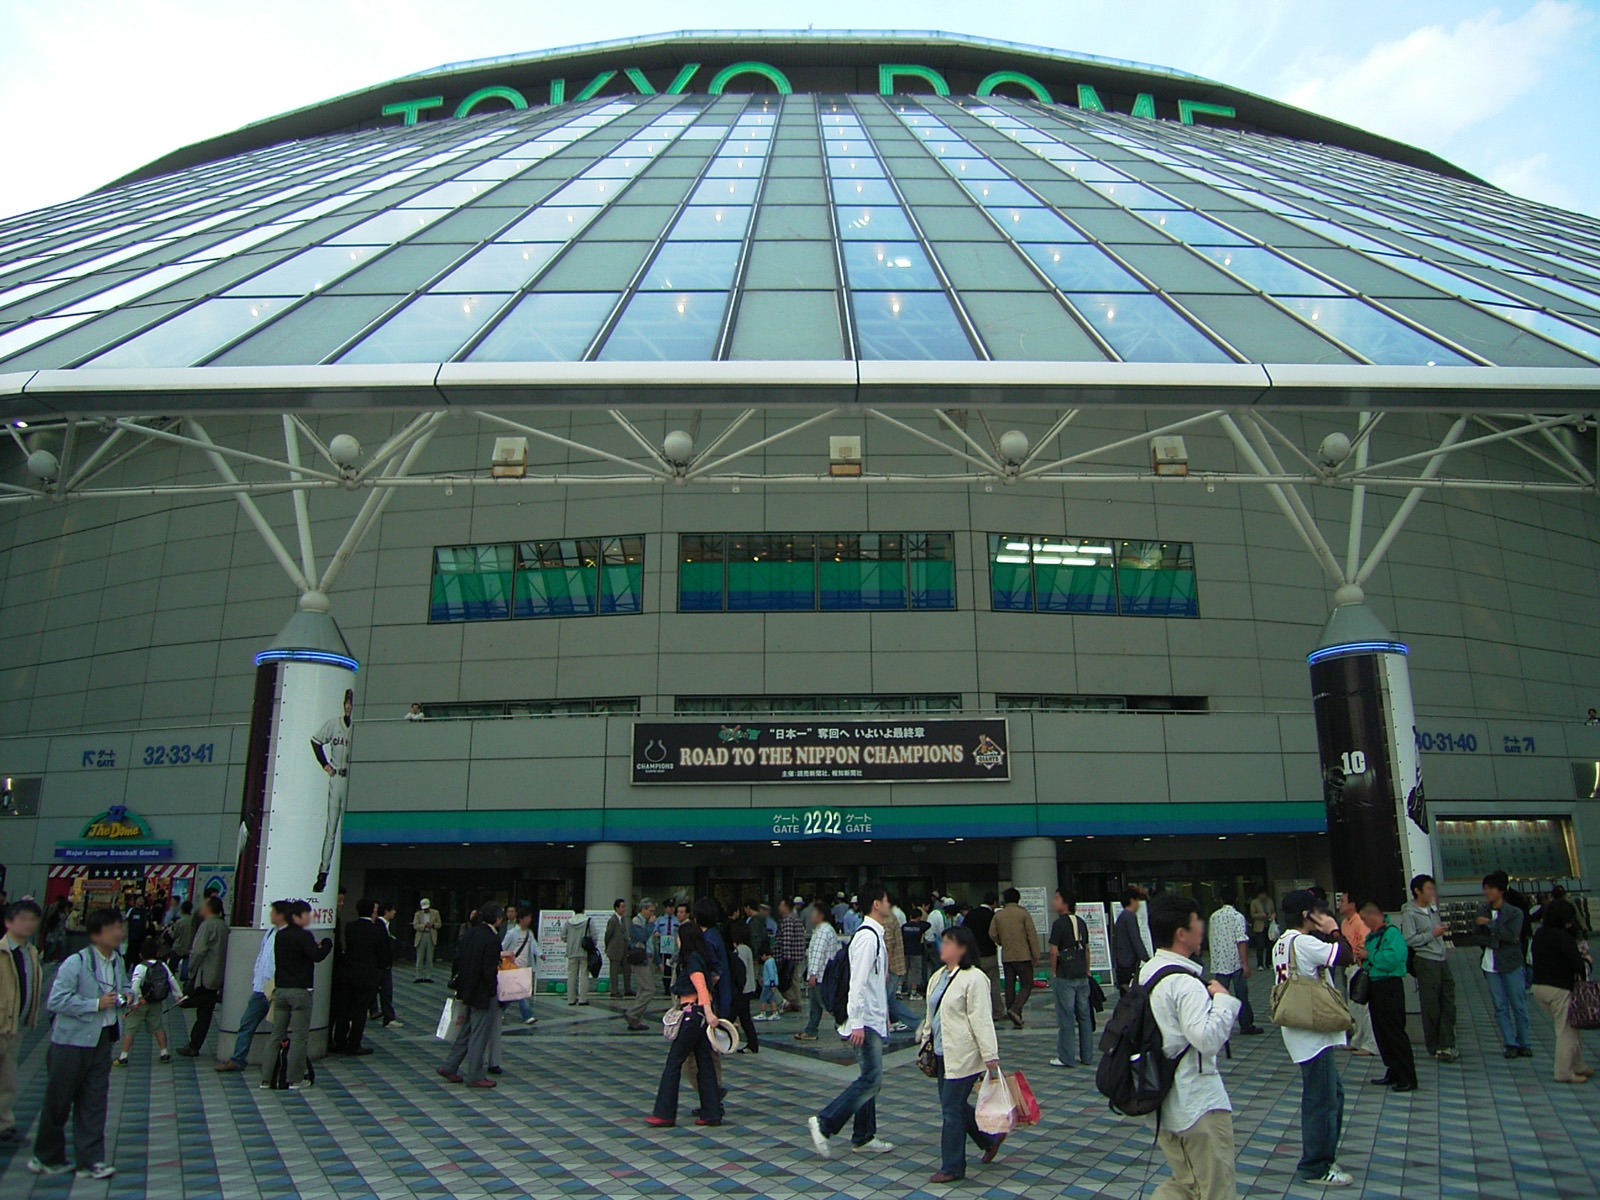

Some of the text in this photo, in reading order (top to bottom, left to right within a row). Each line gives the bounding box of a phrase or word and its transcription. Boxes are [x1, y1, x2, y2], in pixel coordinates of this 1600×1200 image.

[1504, 745, 1521, 753] GATE
[680, 744, 964, 766] ROAD TO THE NIPPON CHAMPIONS
[97, 759, 115, 768] GATE
[1341, 751, 1366, 775] 10
[773, 813, 800, 823] ゲート
[846, 813, 872, 823] ゲート
[88, 823, 140, 839] The Dome
[773, 824, 800, 834] GATE
[845, 823, 872, 833] GATE
[85, 850, 108, 858] League
